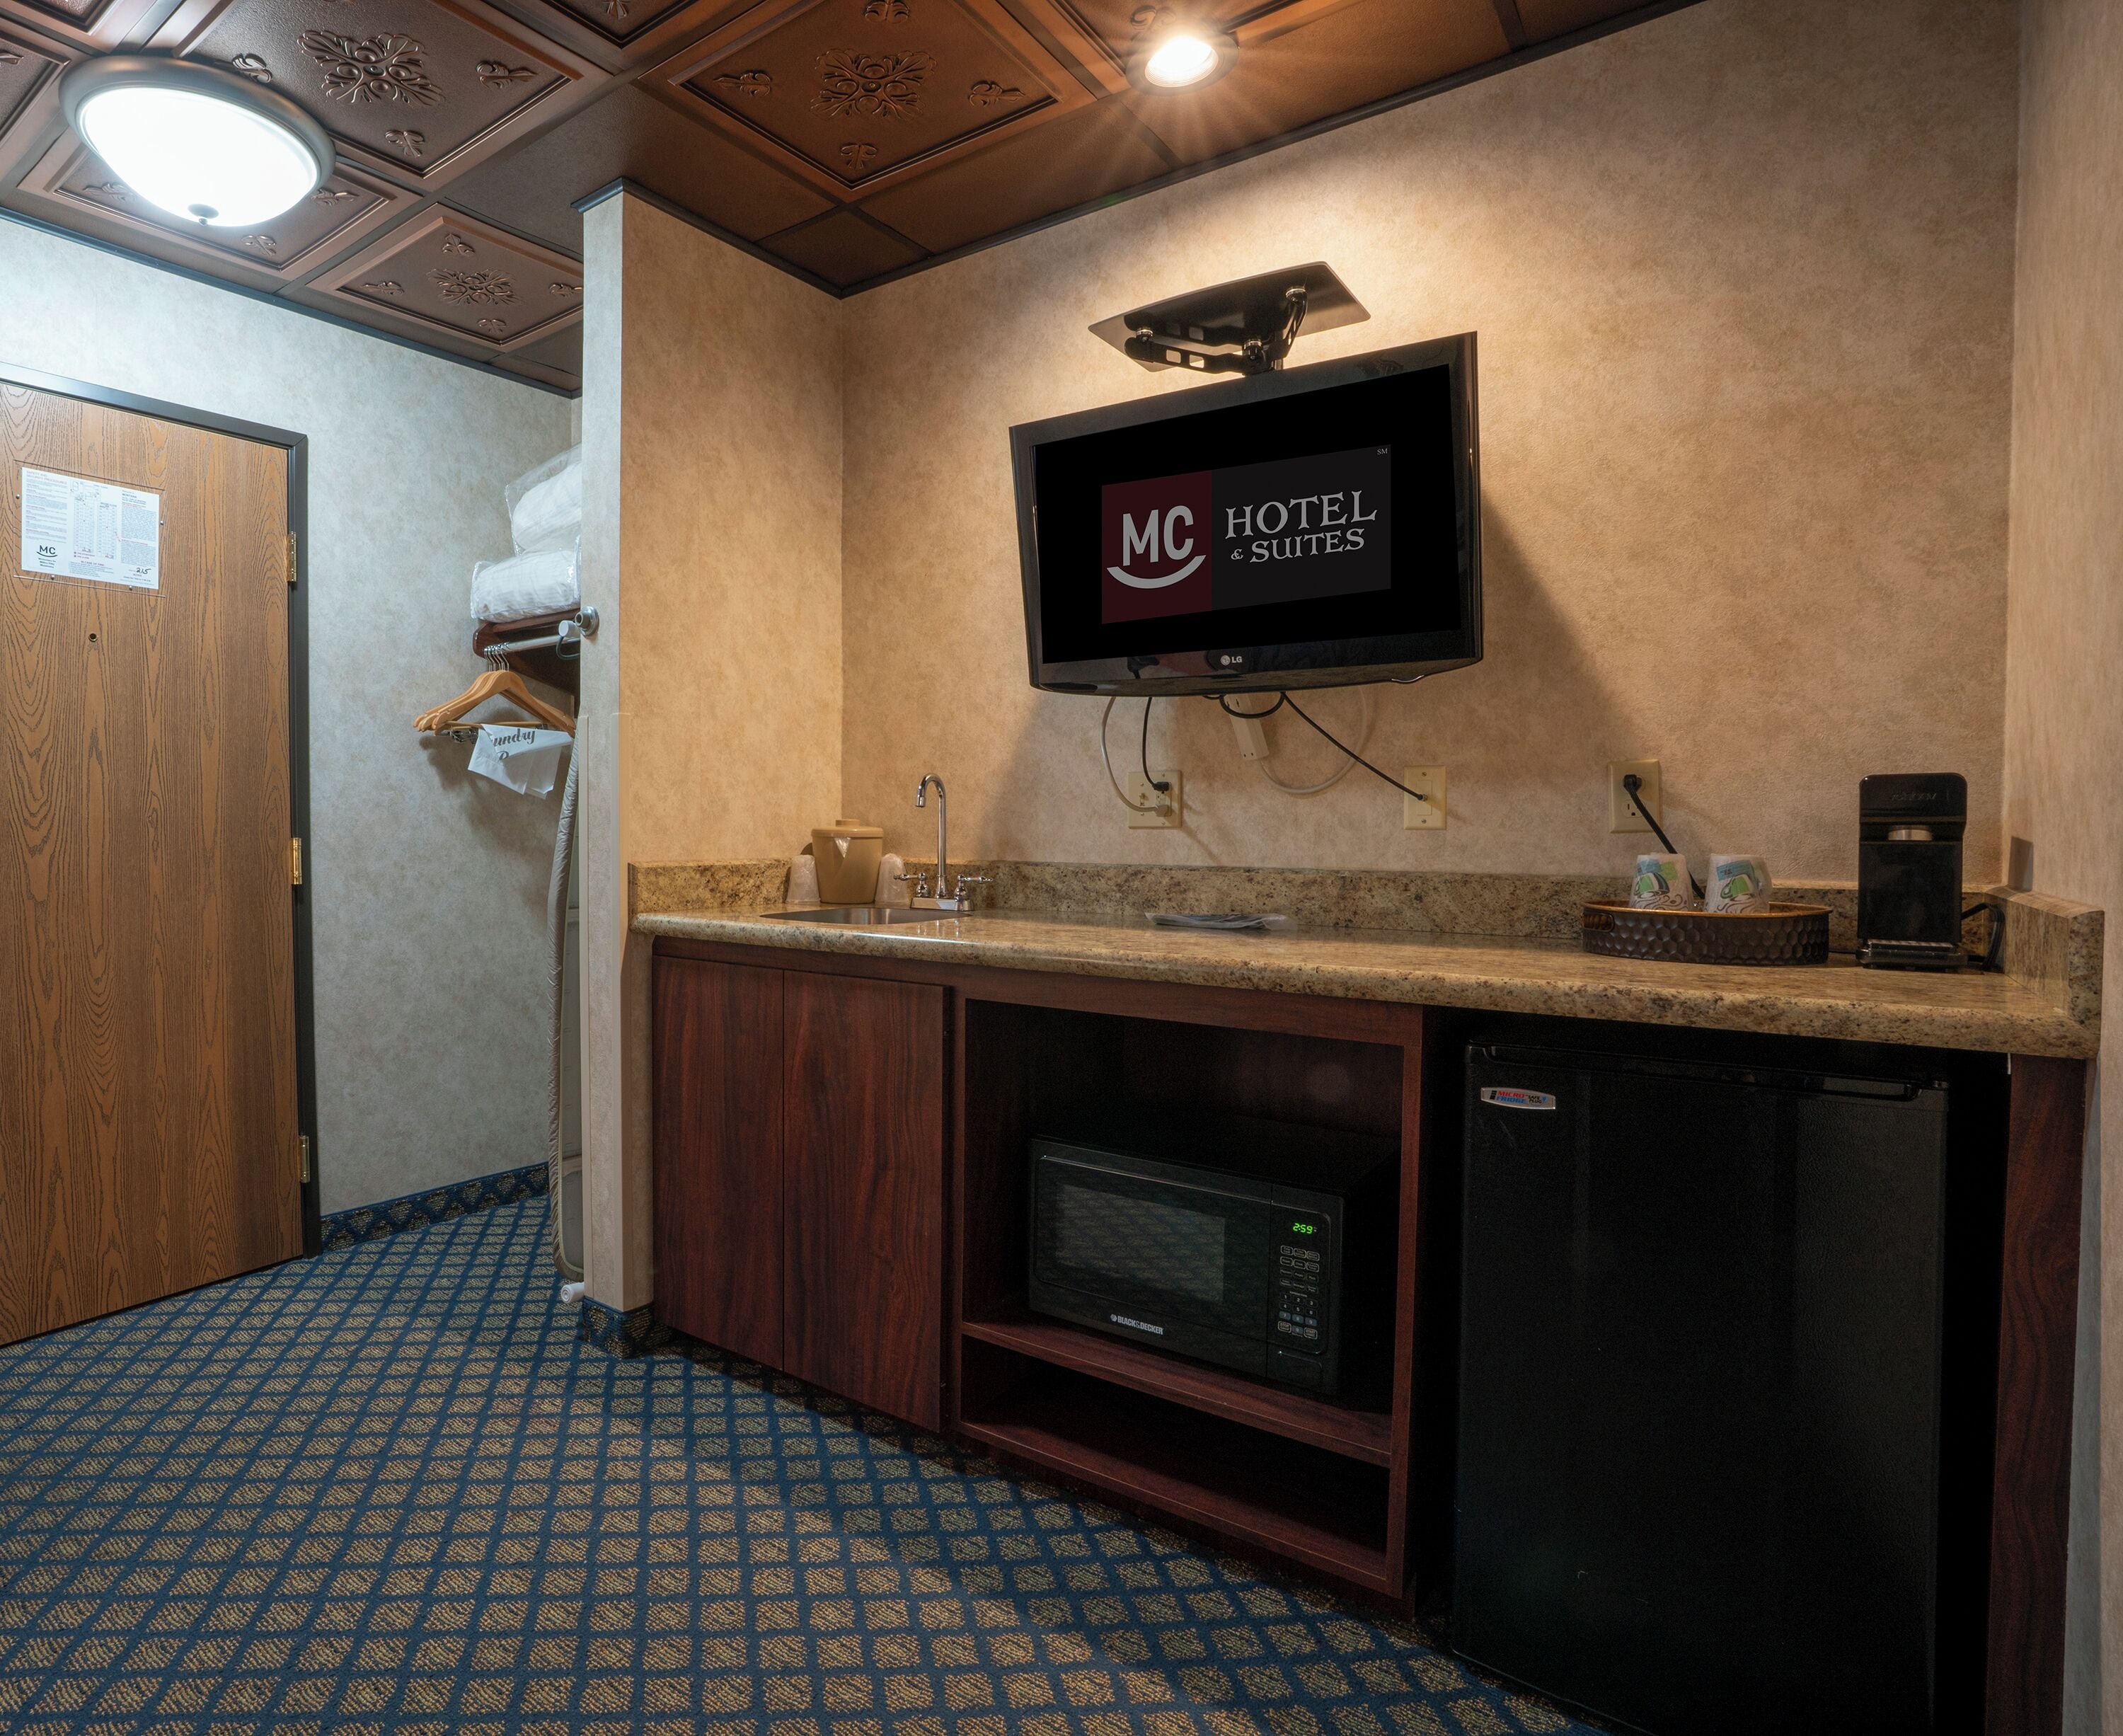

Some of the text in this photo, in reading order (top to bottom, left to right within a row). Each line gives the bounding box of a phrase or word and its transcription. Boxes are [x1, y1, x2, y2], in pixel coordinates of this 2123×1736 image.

[1225, 490, 1378, 539] HOTEL
[1122, 505, 1195, 567] MC
[1231, 529, 1365, 563] & SUITES
[40, 544, 56, 555] MC
[492, 728, 535, 747] undry
[1292, 1223, 1313, 1234] 2:59
[1117, 1315, 1163, 1336] BLACK&DECKER
